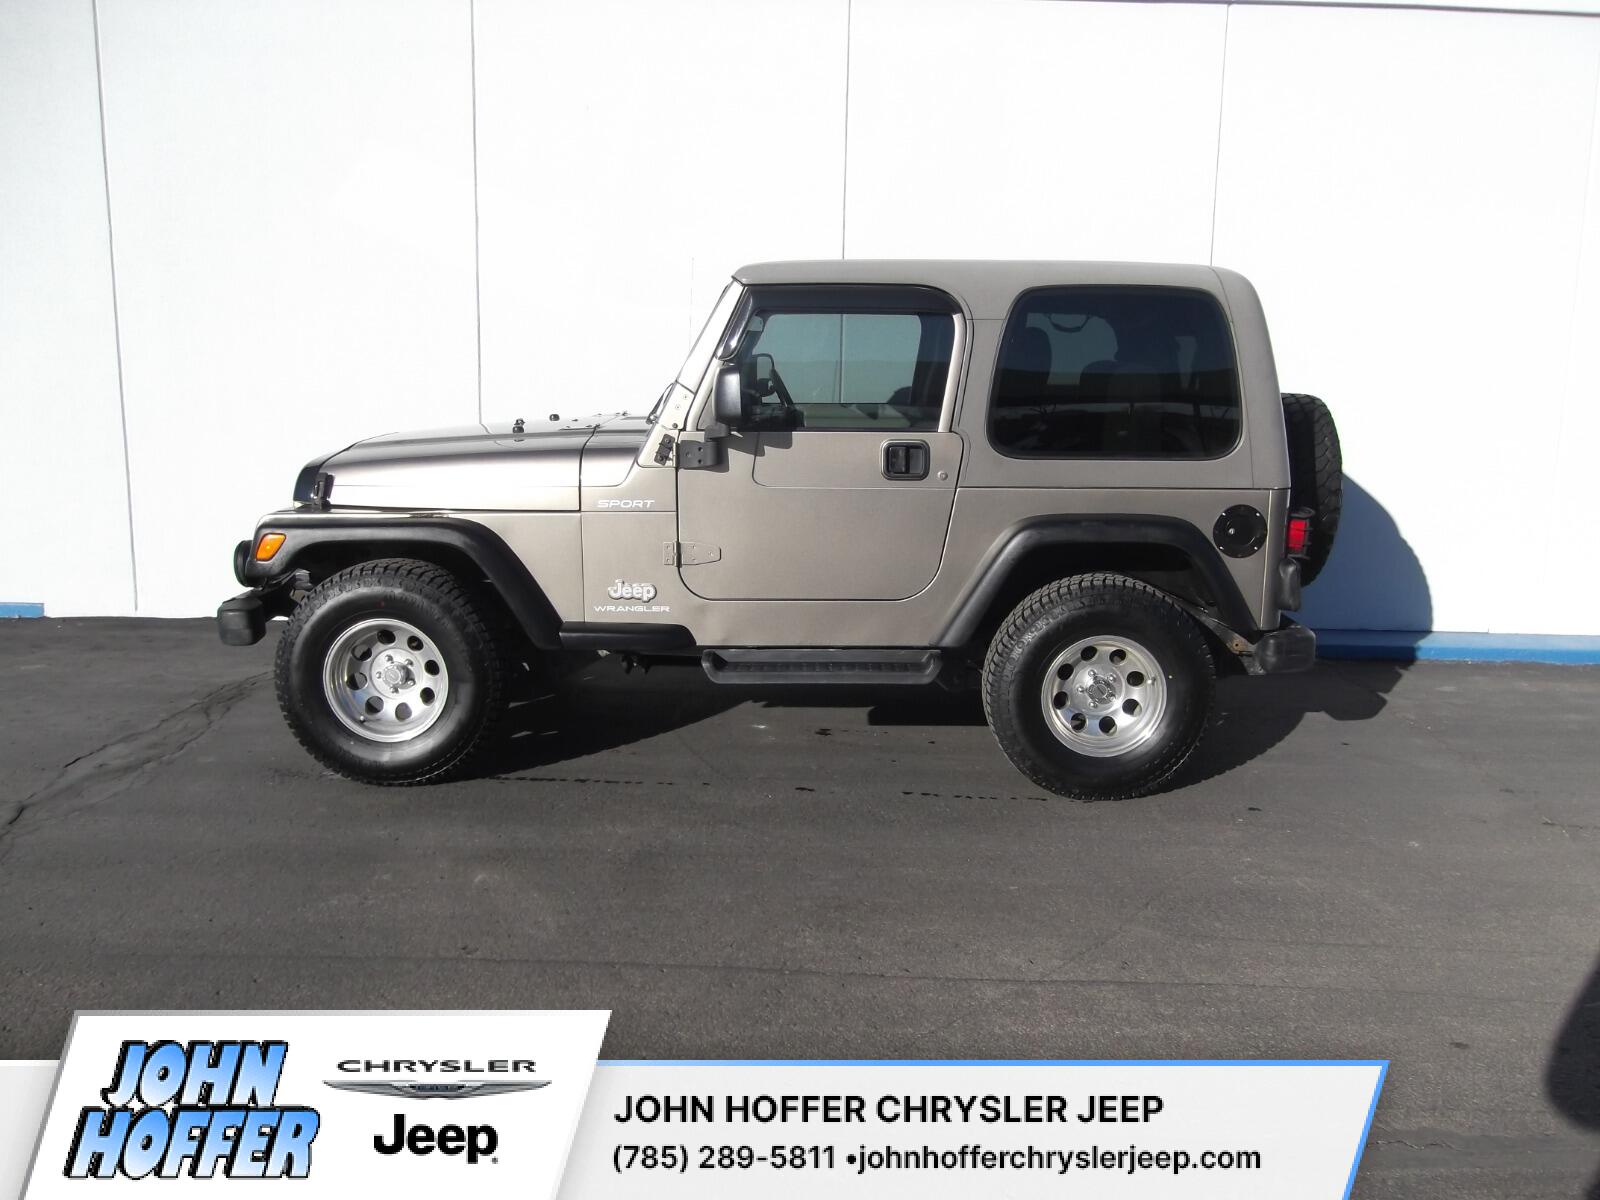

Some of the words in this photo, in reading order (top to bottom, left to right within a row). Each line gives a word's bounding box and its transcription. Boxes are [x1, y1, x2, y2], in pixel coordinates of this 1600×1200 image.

[597, 499, 656, 509] SPORT
[607, 578, 657, 603] Jeep
[593, 605, 671, 613] WRANGLER
